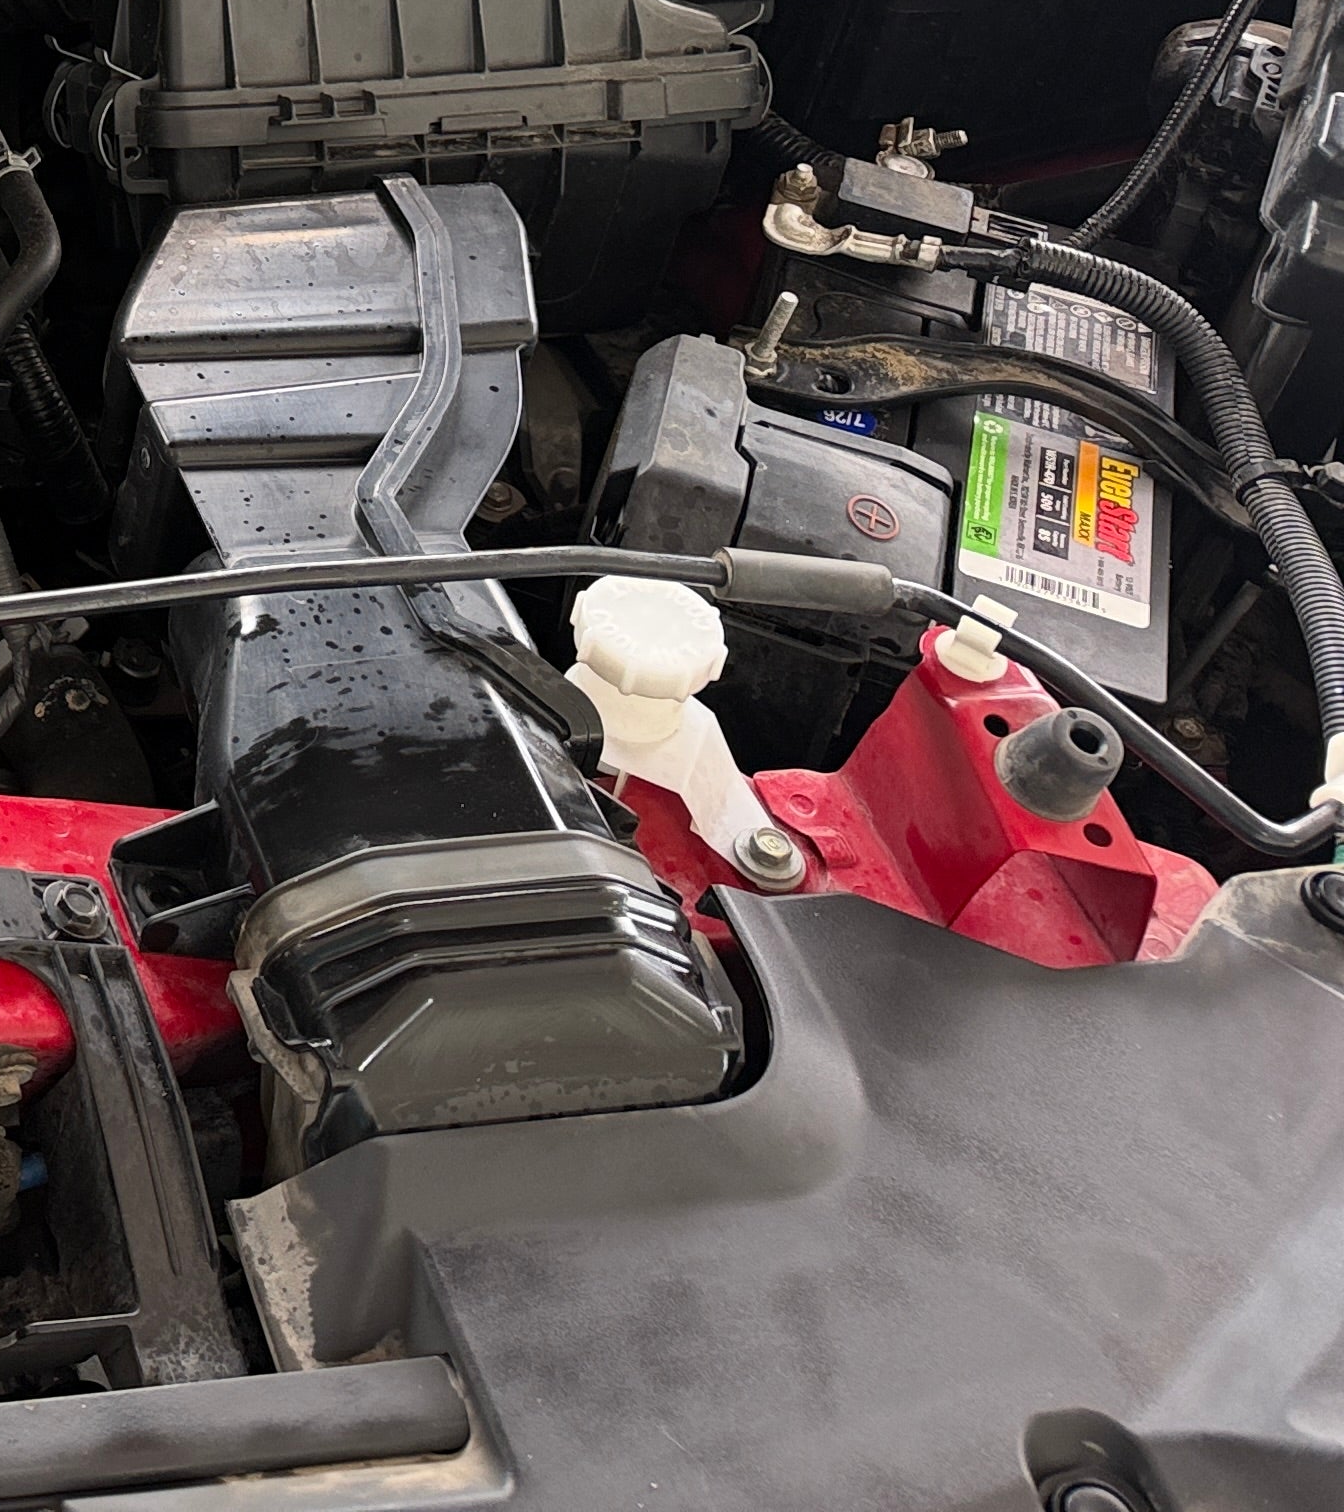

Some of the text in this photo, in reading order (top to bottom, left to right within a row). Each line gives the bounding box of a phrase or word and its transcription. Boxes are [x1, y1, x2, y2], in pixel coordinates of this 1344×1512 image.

[823, 409, 866, 429] 7/26
[1039, 492, 1055, 511] 500
[1095, 455, 1142, 565] EverStart
[1038, 528, 1053, 542] 85
[1078, 511, 1091, 541] MAXX
